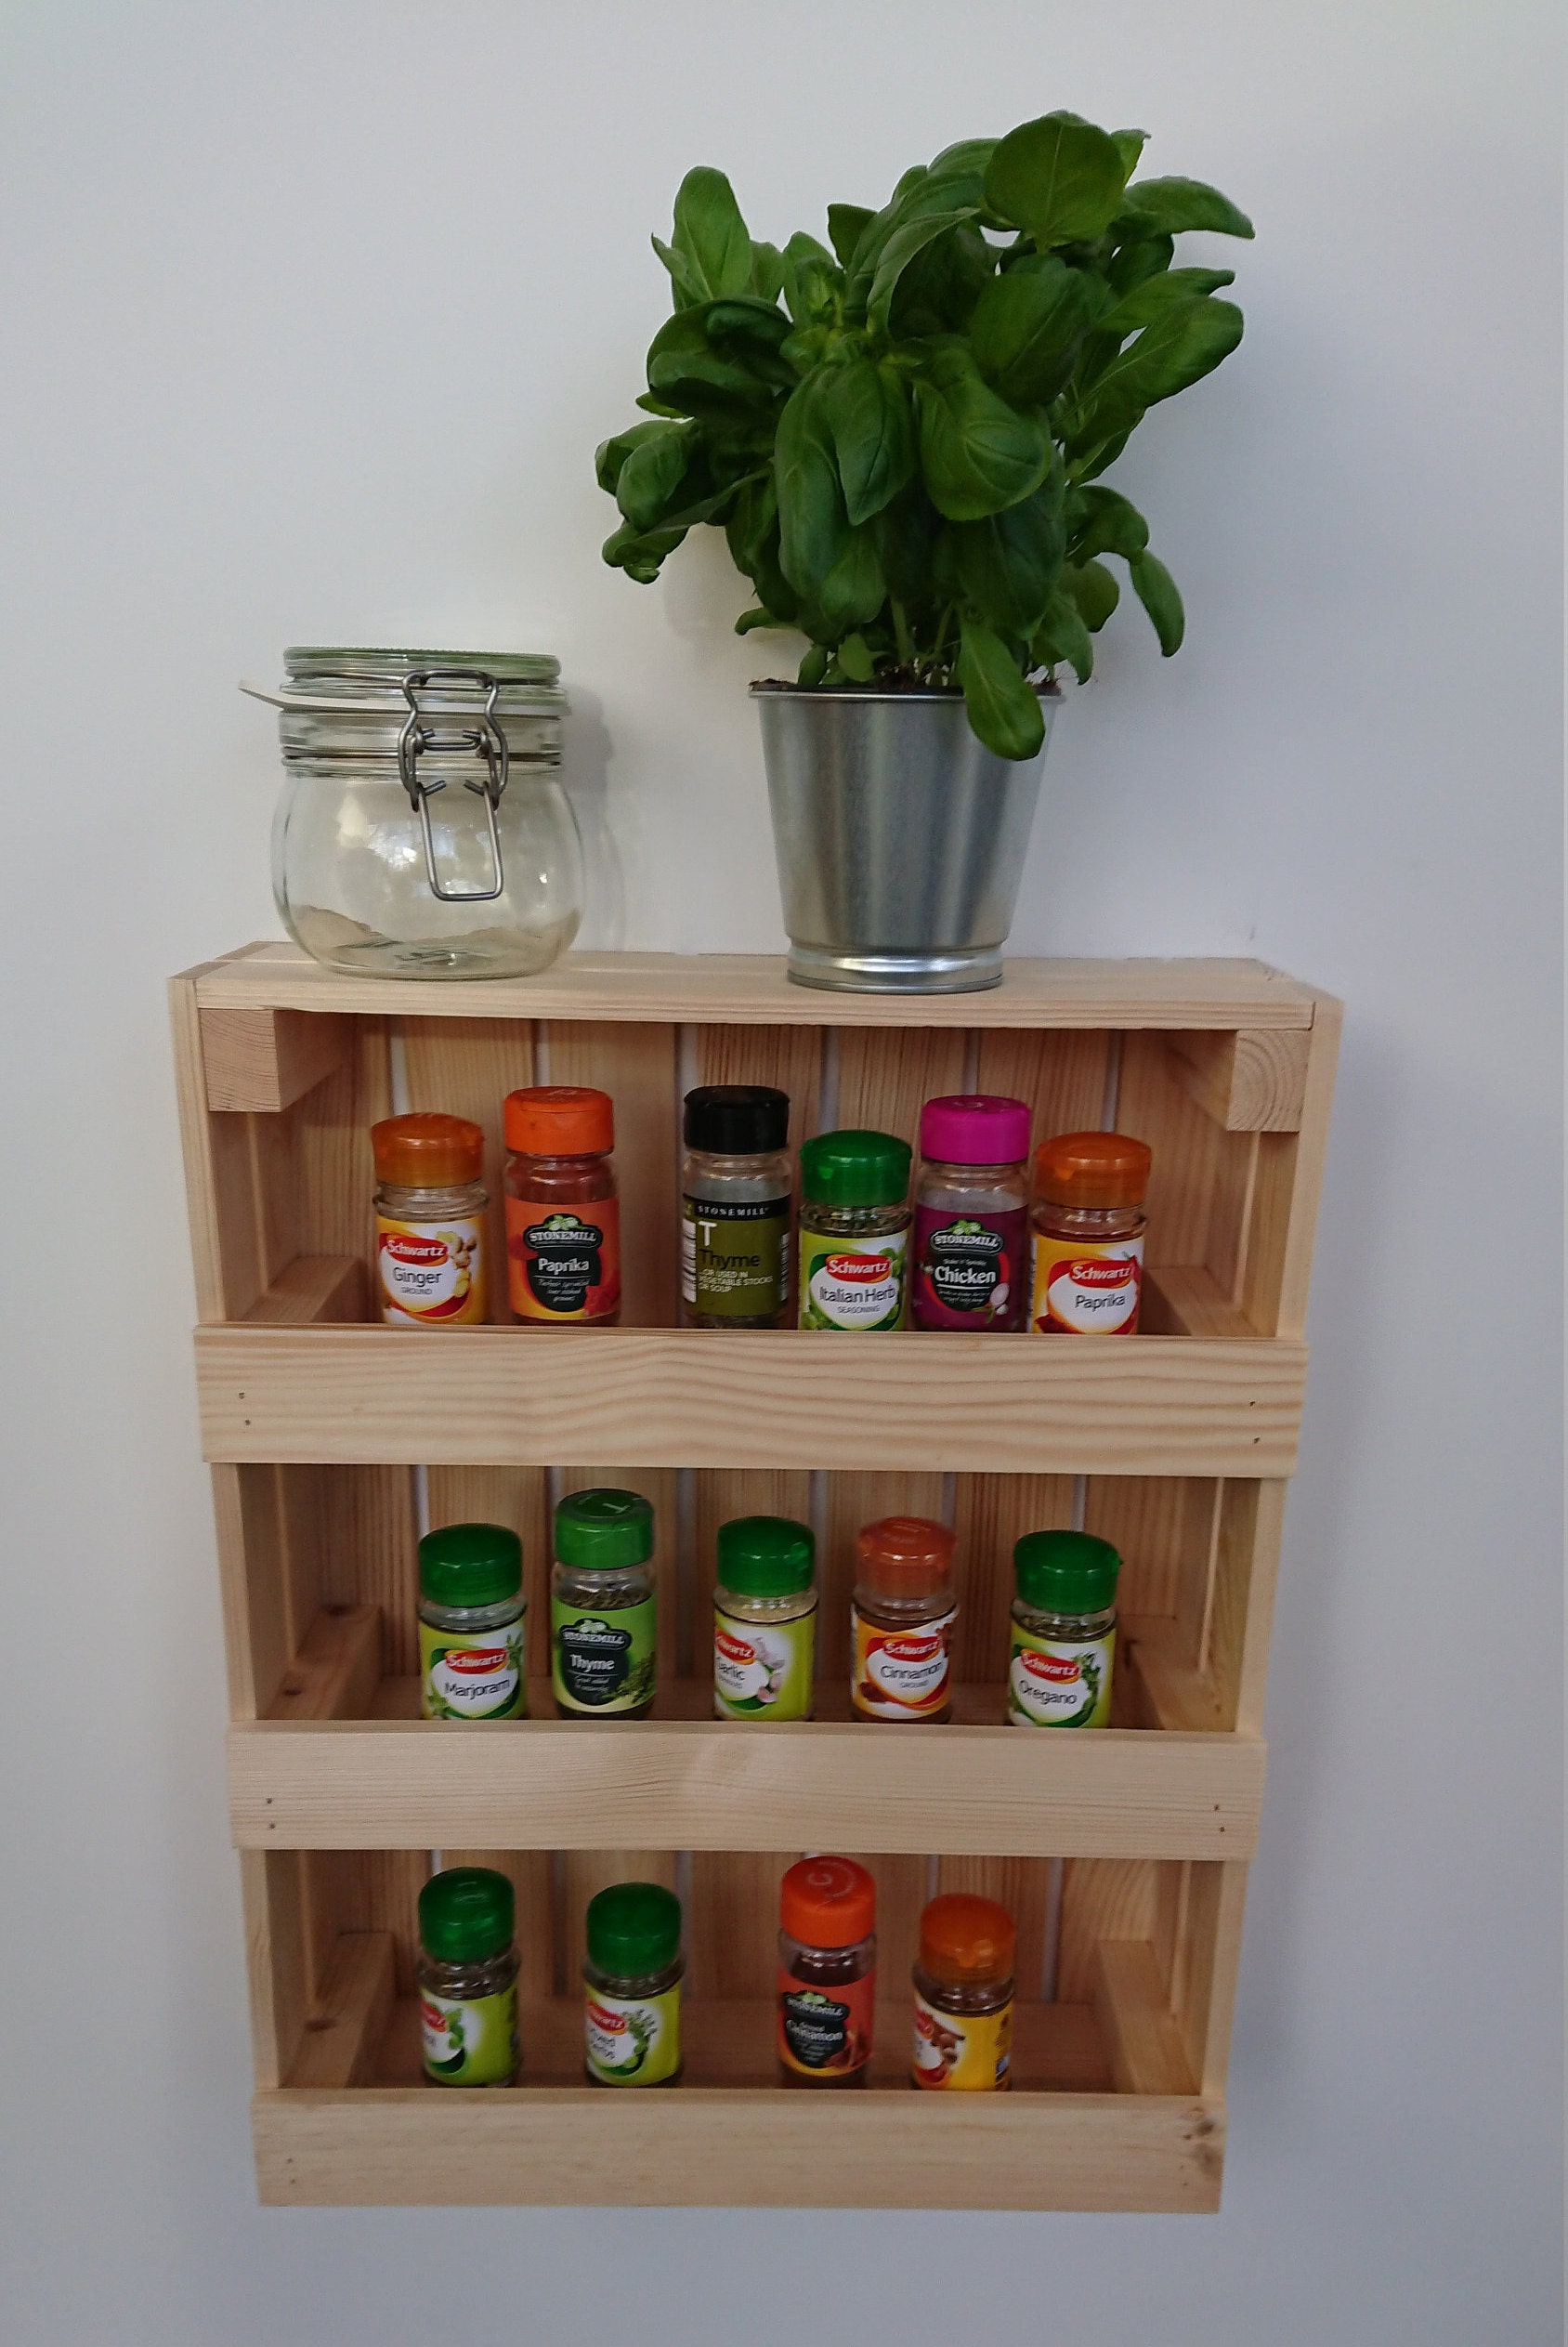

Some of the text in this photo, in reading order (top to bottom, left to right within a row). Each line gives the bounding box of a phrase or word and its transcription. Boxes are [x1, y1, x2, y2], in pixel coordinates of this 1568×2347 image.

[697, 1205, 766, 1216] STONEMILL
[529, 1230, 596, 1242] STONEMILL
[698, 1220, 718, 1247] T
[934, 1235, 999, 1247] STONEMILL
[386, 1239, 445, 1257] Schwartz
[538, 1257, 590, 1275] Paprika
[698, 1249, 761, 1270] Thyme
[828, 1259, 889, 1275] Schwartz
[393, 1266, 443, 1288] Ginger
[934, 1265, 997, 1284] Chicken
[1072, 1265, 1131, 1280] Schwartz
[819, 1286, 863, 1303] Italian
[1074, 1292, 1126, 1312] Paprika
[563, 1632, 625, 1645] STONEMILL
[884, 1641, 939, 1655] Schwartz
[446, 1654, 505, 1668] Schwartz
[569, 1654, 615, 1672] Thyme
[1021, 1653, 1078, 1676] Schwartz
[444, 1679, 510, 1700] Marjoram
[1018, 1679, 1078, 1705] Oregano
